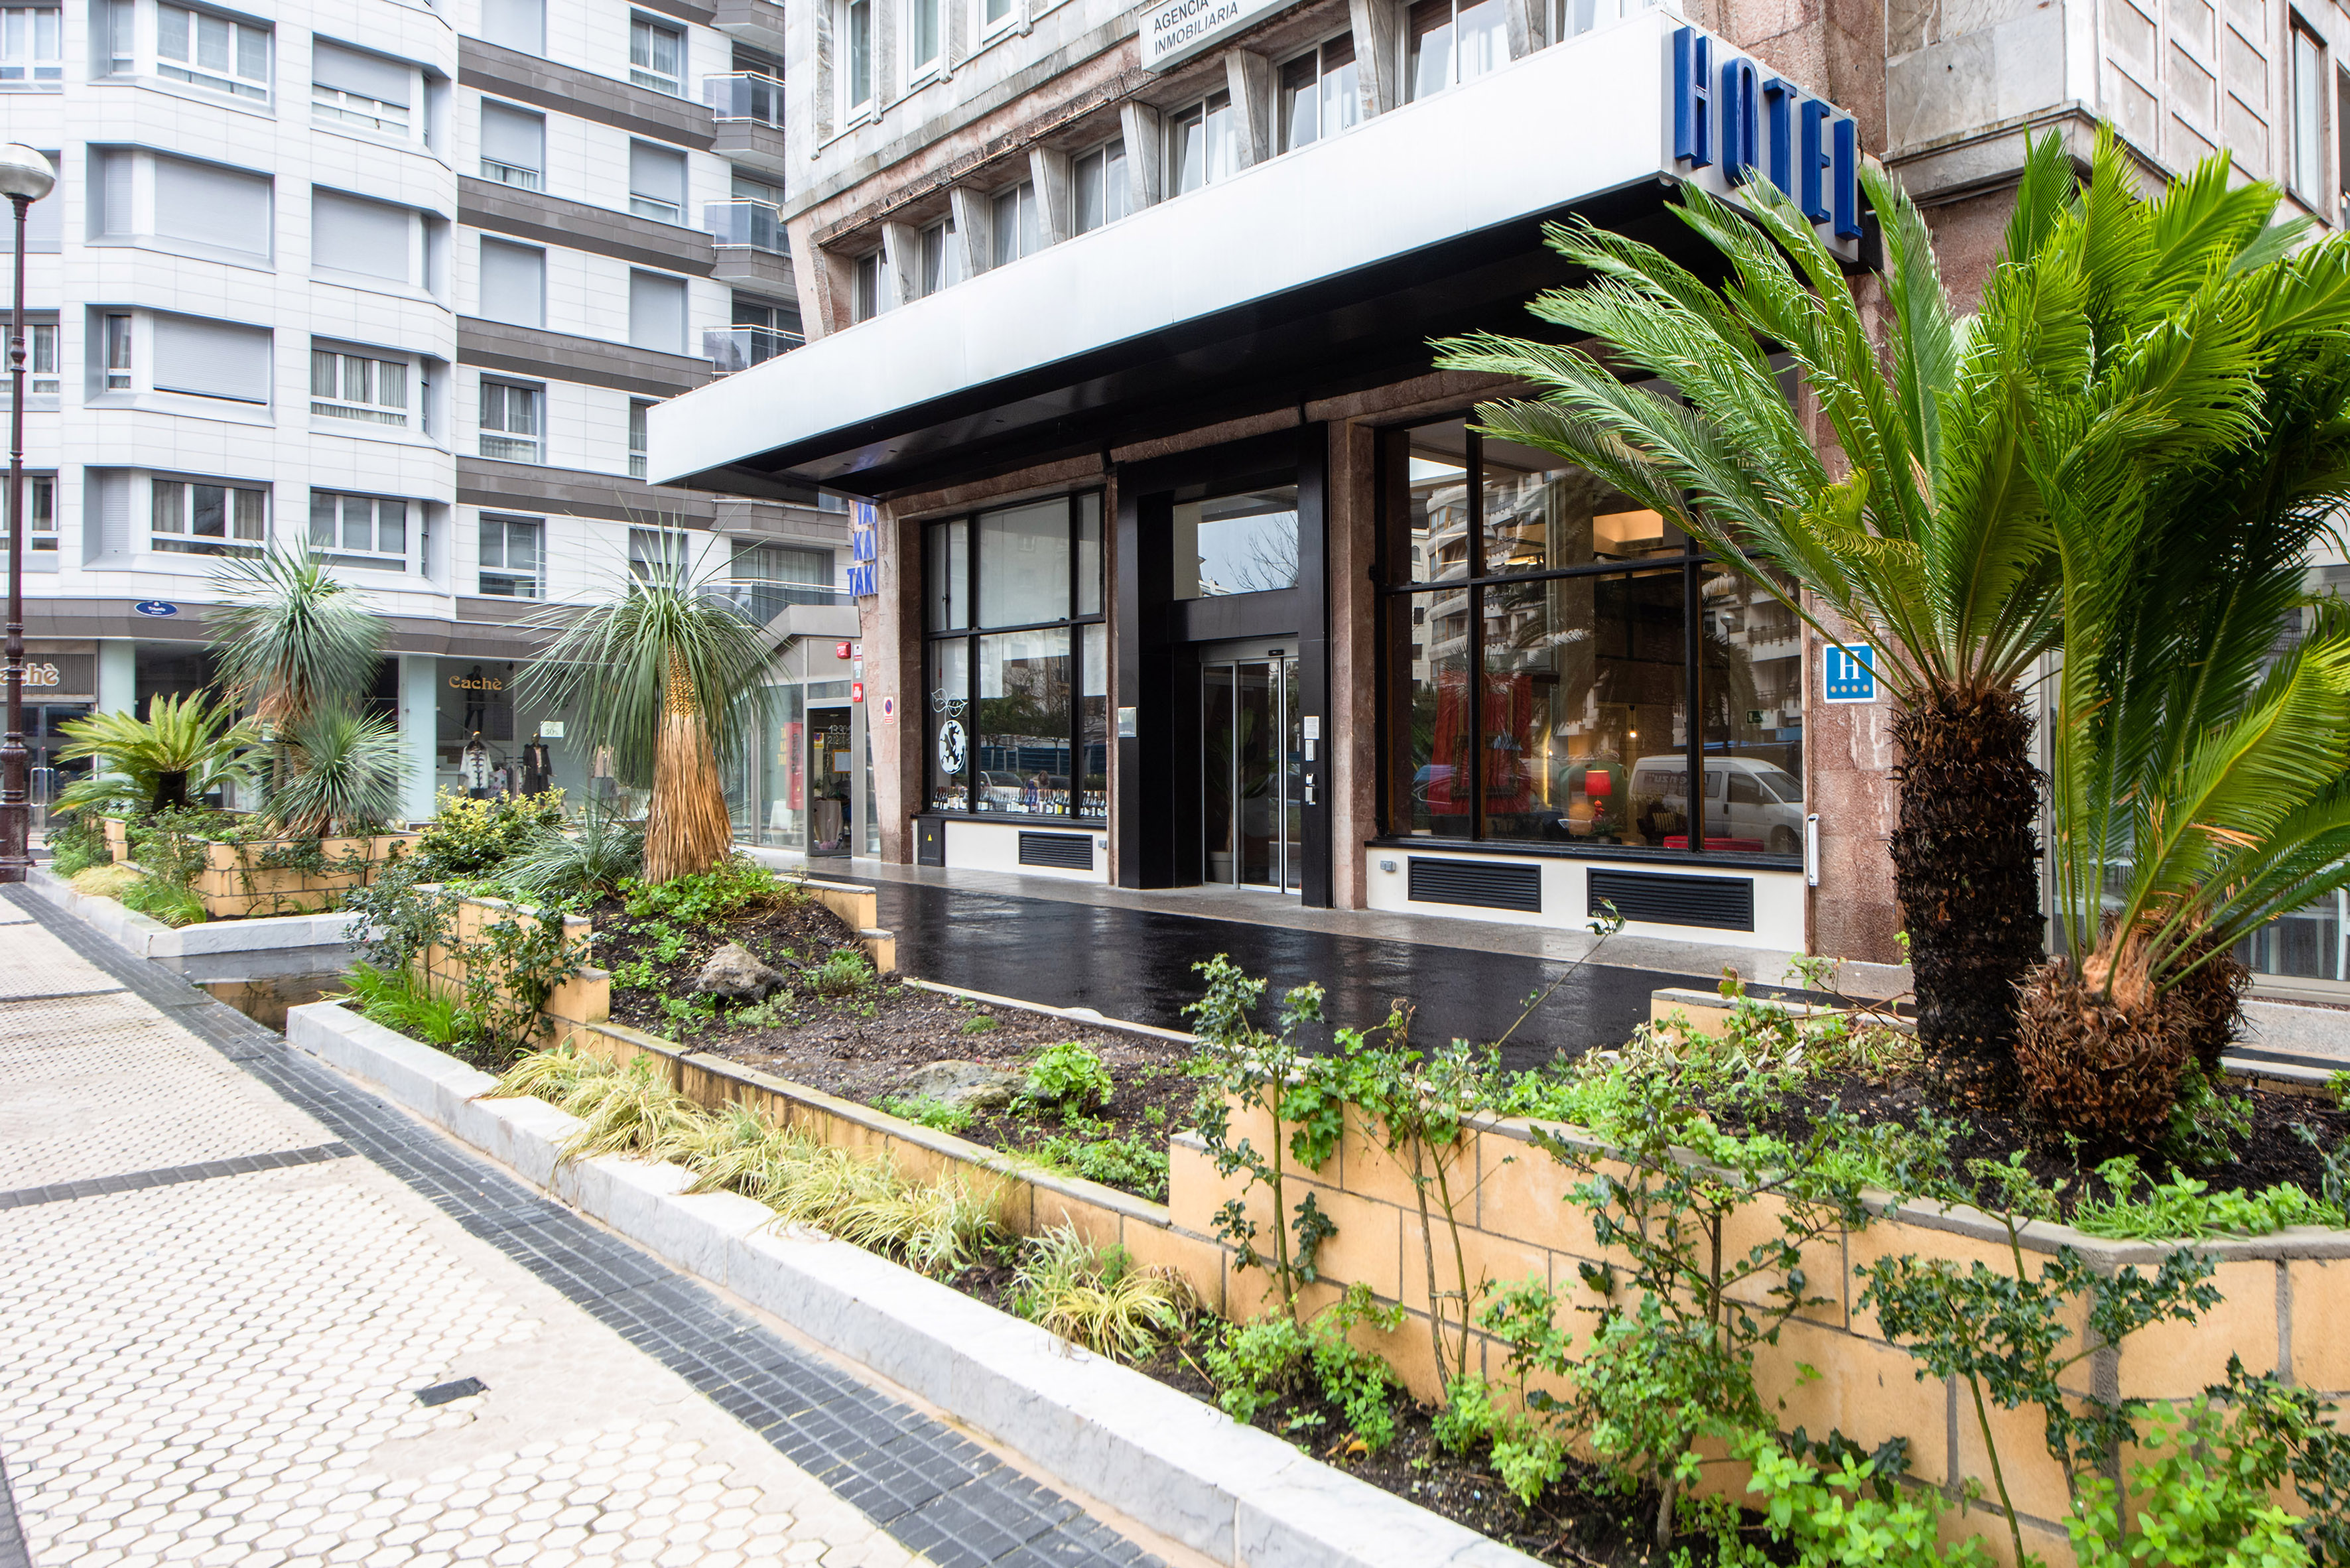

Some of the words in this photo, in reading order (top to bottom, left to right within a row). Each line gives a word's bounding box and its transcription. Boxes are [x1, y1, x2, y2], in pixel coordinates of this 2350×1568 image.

[1154, 0, 1208, 34] AGENCIA
[1155, 1, 1238, 55] INMOBILIARIA
[1673, 26, 1862, 241] HOTEL
[854, 530, 874, 561] KA
[1838, 651, 1860, 680] H
[448, 675, 503, 690] Cachè
